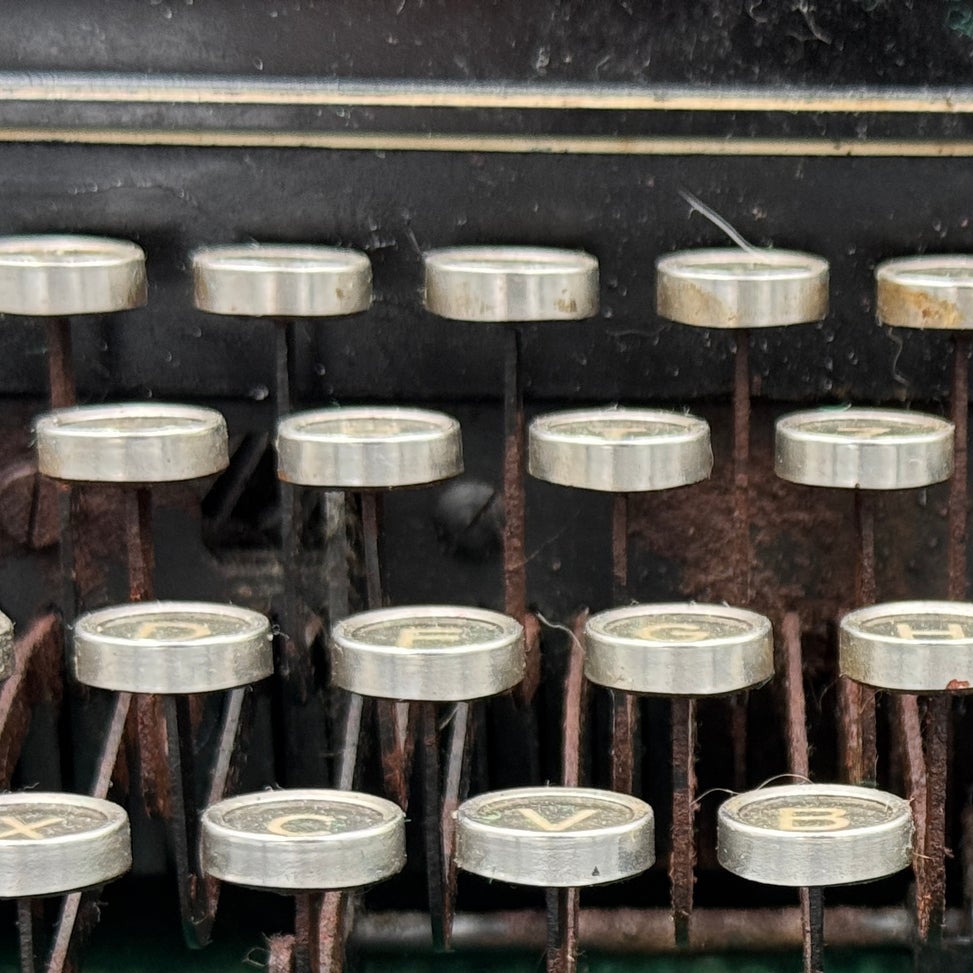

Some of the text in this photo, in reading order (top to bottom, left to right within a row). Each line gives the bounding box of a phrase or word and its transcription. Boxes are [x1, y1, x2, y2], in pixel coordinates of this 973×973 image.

[400, 627, 463, 648] F
[641, 622, 708, 641] G
[897, 622, 965, 640] H
[0, 814, 65, 840] X
[266, 813, 342, 837] C
[519, 807, 599, 831] V
[776, 807, 850, 831] B
